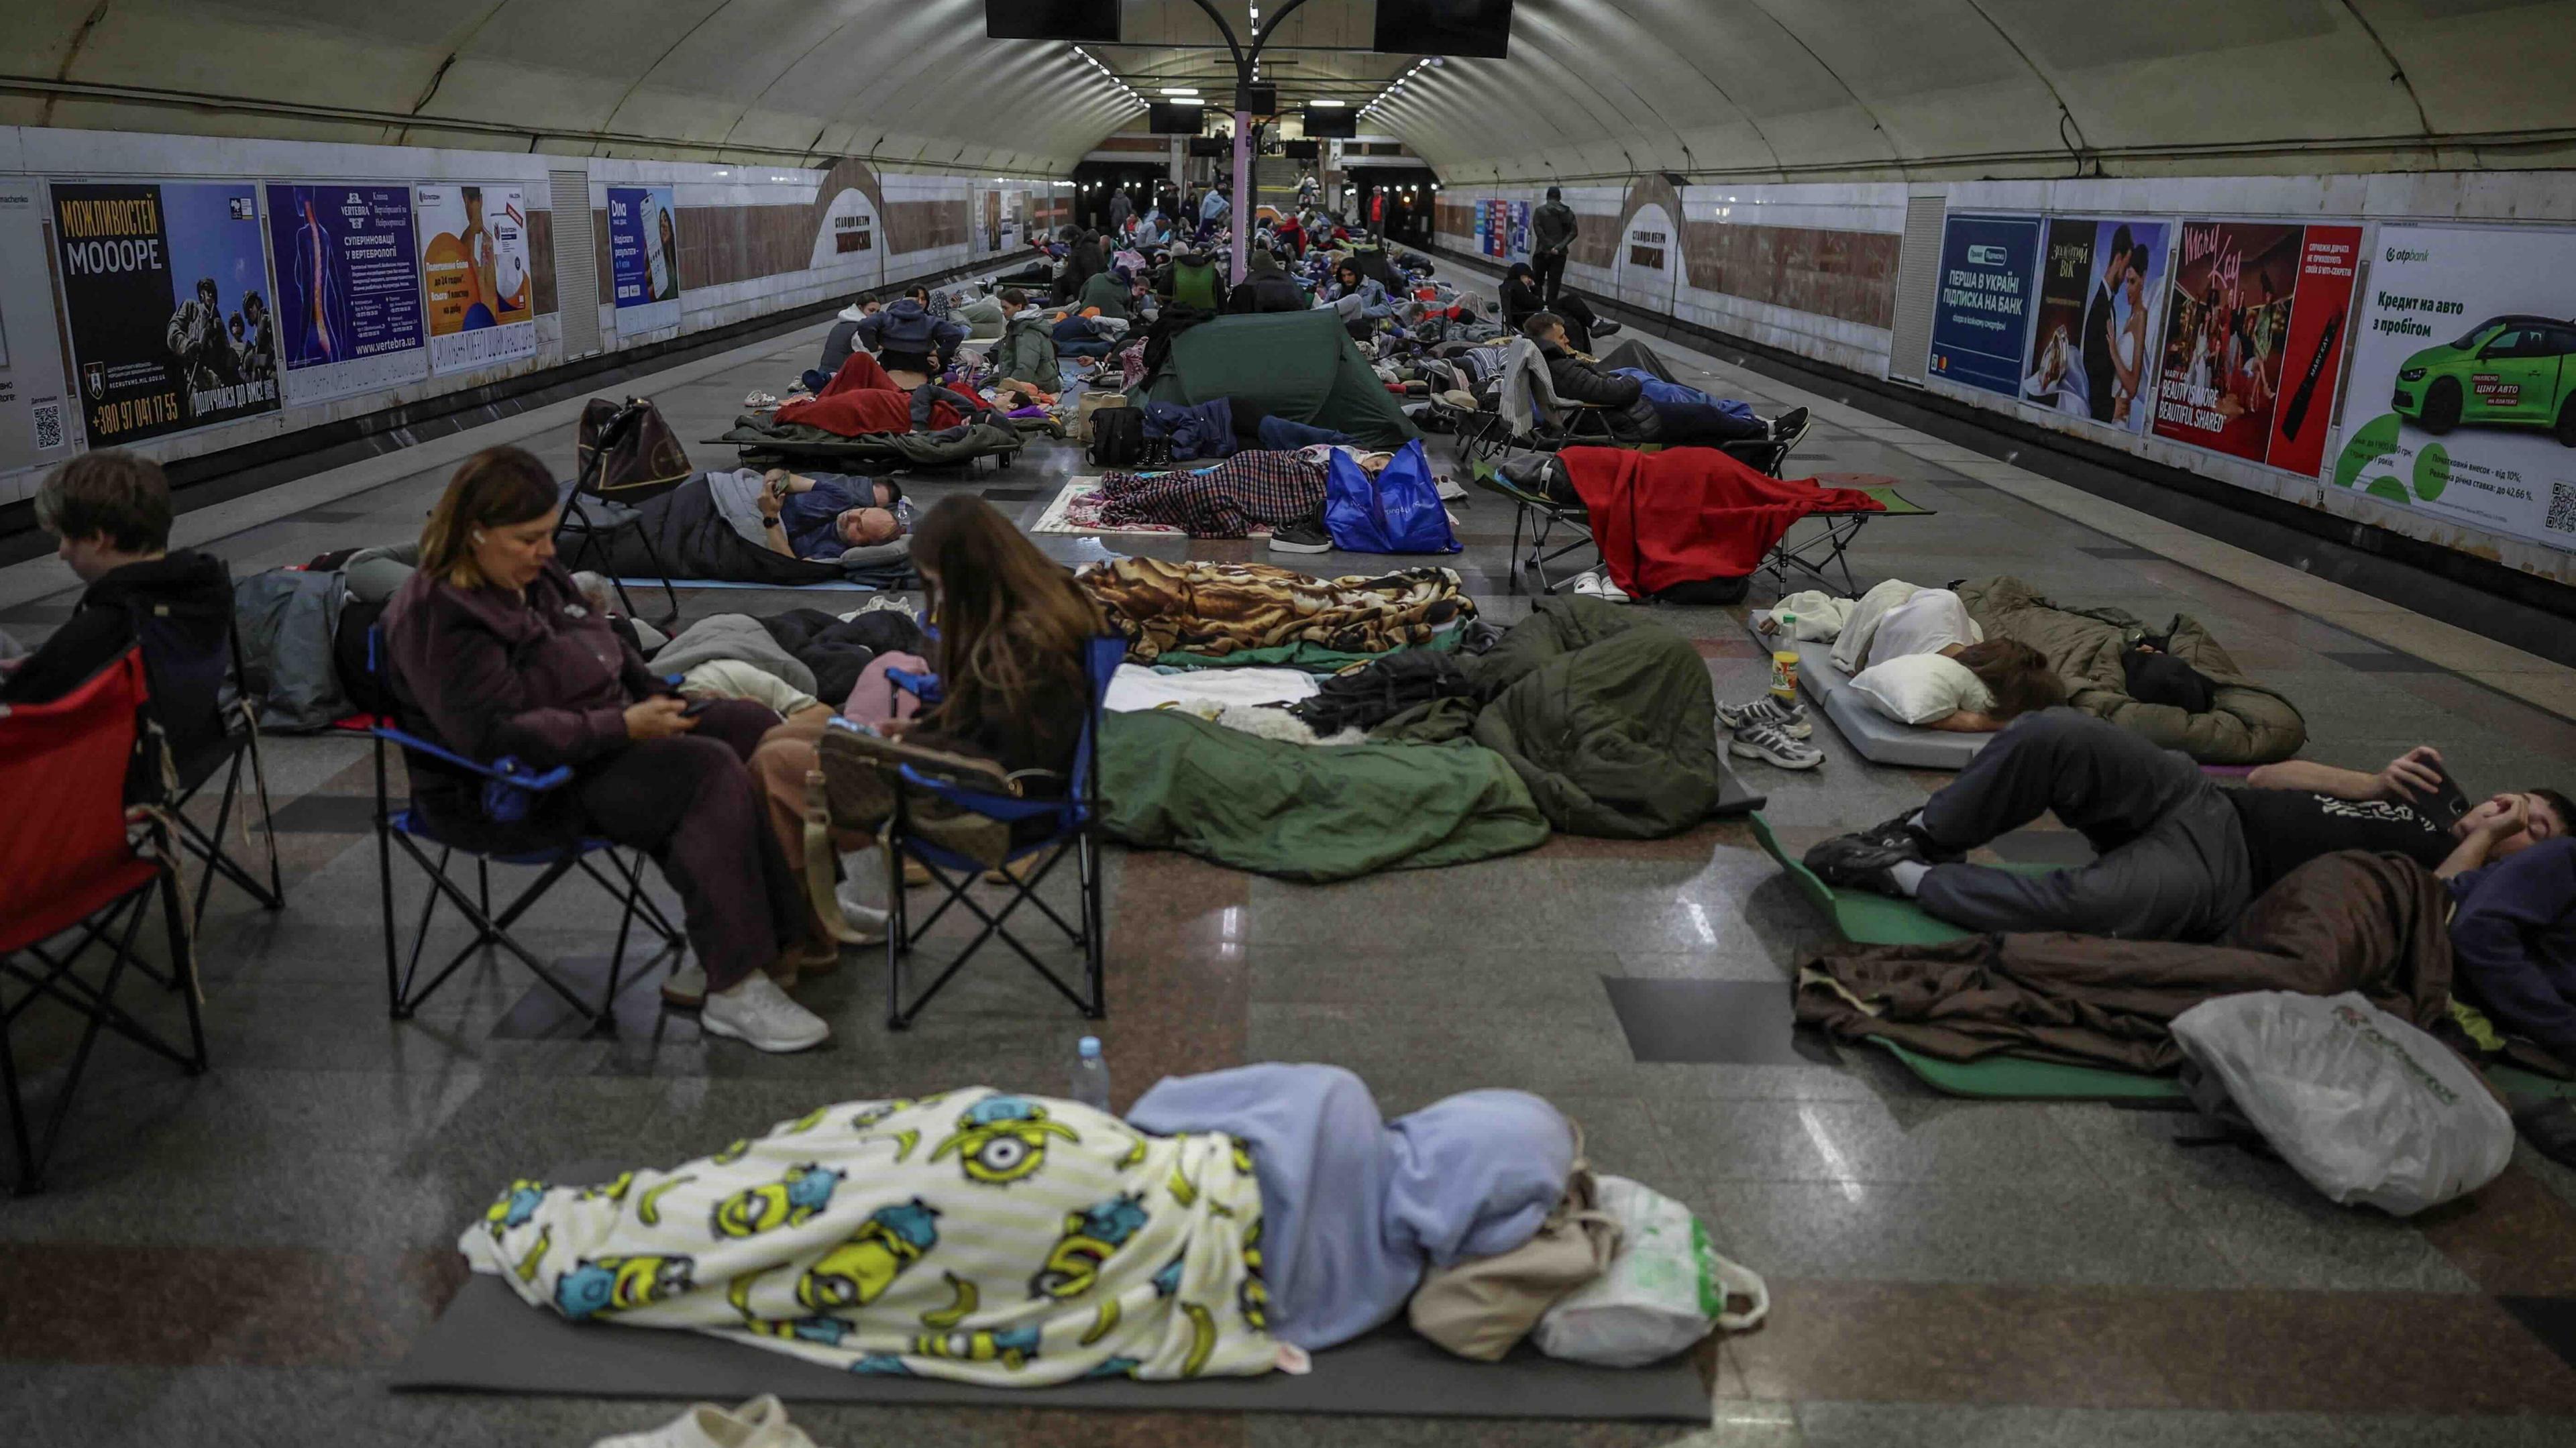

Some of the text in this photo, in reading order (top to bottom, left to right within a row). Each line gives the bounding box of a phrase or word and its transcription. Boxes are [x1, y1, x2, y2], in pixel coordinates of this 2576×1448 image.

[60, 193, 158, 237] МОЖЛИВОСТЕЙ
[341, 206, 370, 216] VERTEBRA
[344, 232, 394, 246] СУПЕРІННОВАЦІЇ
[345, 245, 396, 260] У ВЕРТЕБРОЛОГІЇ
[2184, 223, 2220, 267] Mary
[67, 239, 162, 275] МОООРЕ
[1949, 270, 2019, 294] ПЕРША В УКРАЇНІ
[2207, 235, 2242, 310] Kay
[1943, 288, 1984, 309] ПІДПИСКА
[1984, 294, 1997, 312] НА
[1998, 296, 2023, 316] БАНК
[2377, 291, 2464, 315] Кредит на авто
[2373, 317, 2432, 337] з пробігом
[356, 337, 415, 355] www.vertebra.ua
[2165, 369, 2180, 378] MARY
[2310, 353, 2322, 377] MARY
[194, 378, 264, 417] ДОЛУЧАЙСЯ ДО ВМС!
[2161, 379, 2189, 402] BEAUTY
[2187, 385, 2196, 406] IS
[2477, 385, 2519, 394] ЦІНУ АВТО
[93, 392, 178, 435] +380 97 041 17 55
[2159, 400, 2194, 427] BEAUTIFUL
[2432, 453, 2469, 469] Початковий
[2469, 463, 2491, 475] внесок
[2495, 469, 2506, 480] від
[2429, 468, 2455, 482] Реальна
[2455, 474, 2472, 486] річна
[2473, 480, 2496, 492] ставка:
[2496, 486, 2506, 496] до
[2507, 488, 2525, 500] 42,66
